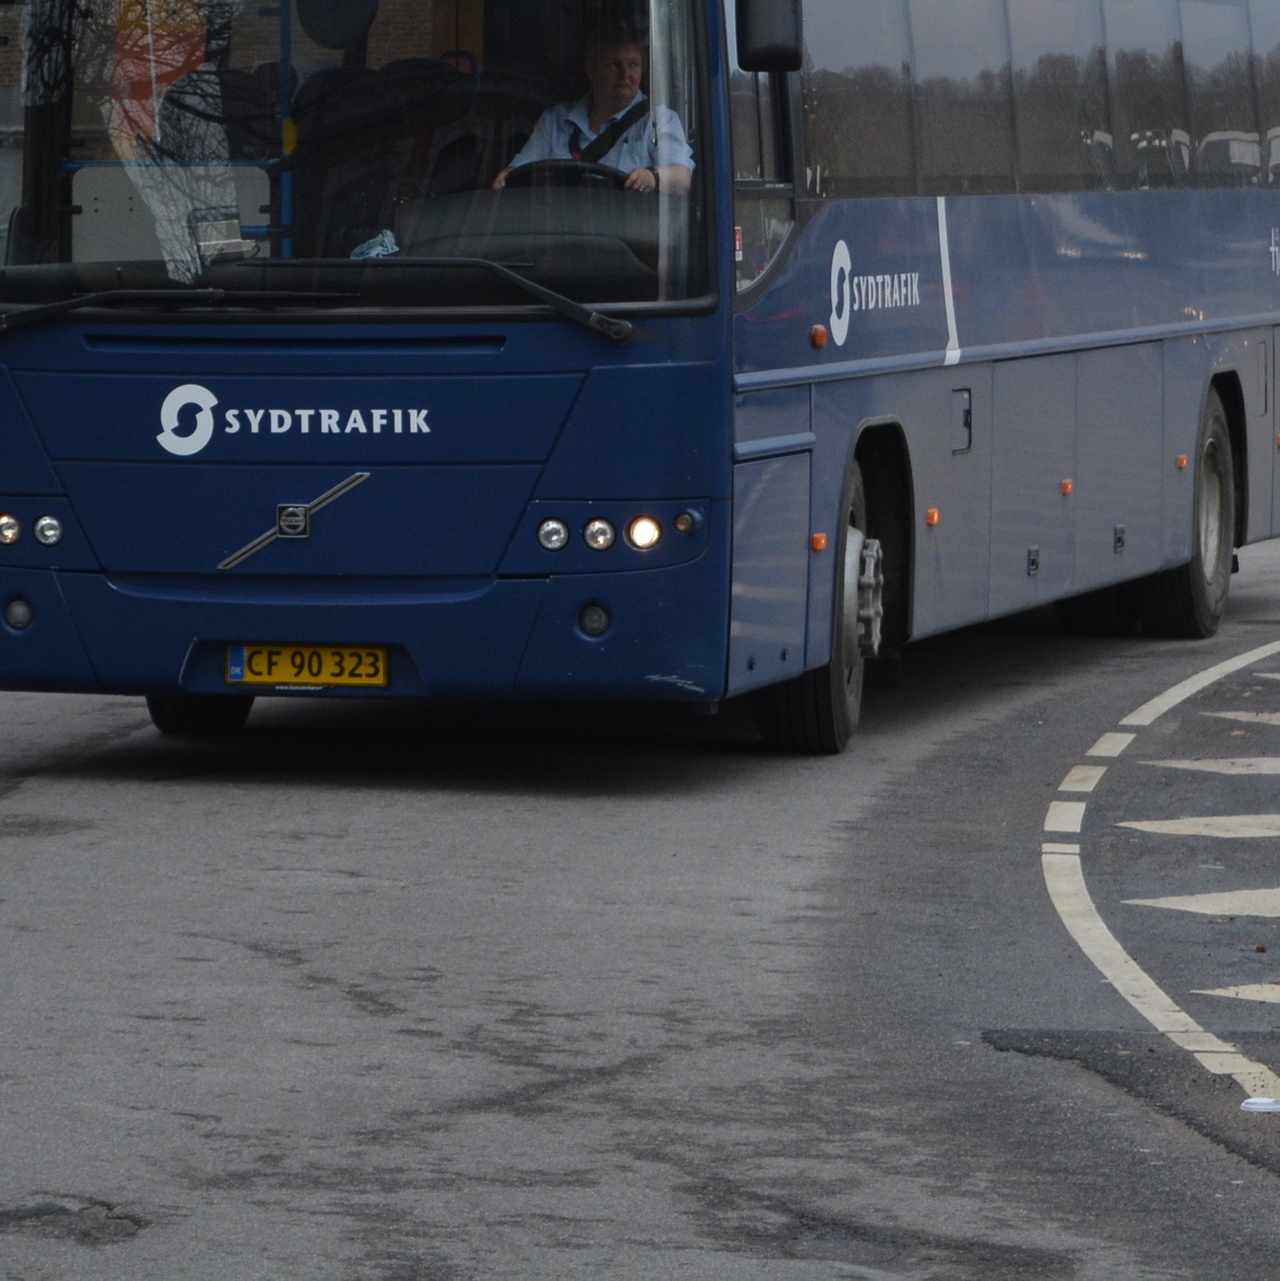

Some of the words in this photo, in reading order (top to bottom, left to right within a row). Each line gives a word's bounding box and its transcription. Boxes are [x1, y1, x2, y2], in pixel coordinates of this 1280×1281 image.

[852, 272, 920, 312] SYDTRAFIK
[224, 408, 431, 434] SYDTRAFIK
[230, 666, 243, 675] DK
[246, 649, 282, 677] CF
[290, 650, 323, 678] 90
[330, 651, 380, 679] 323
